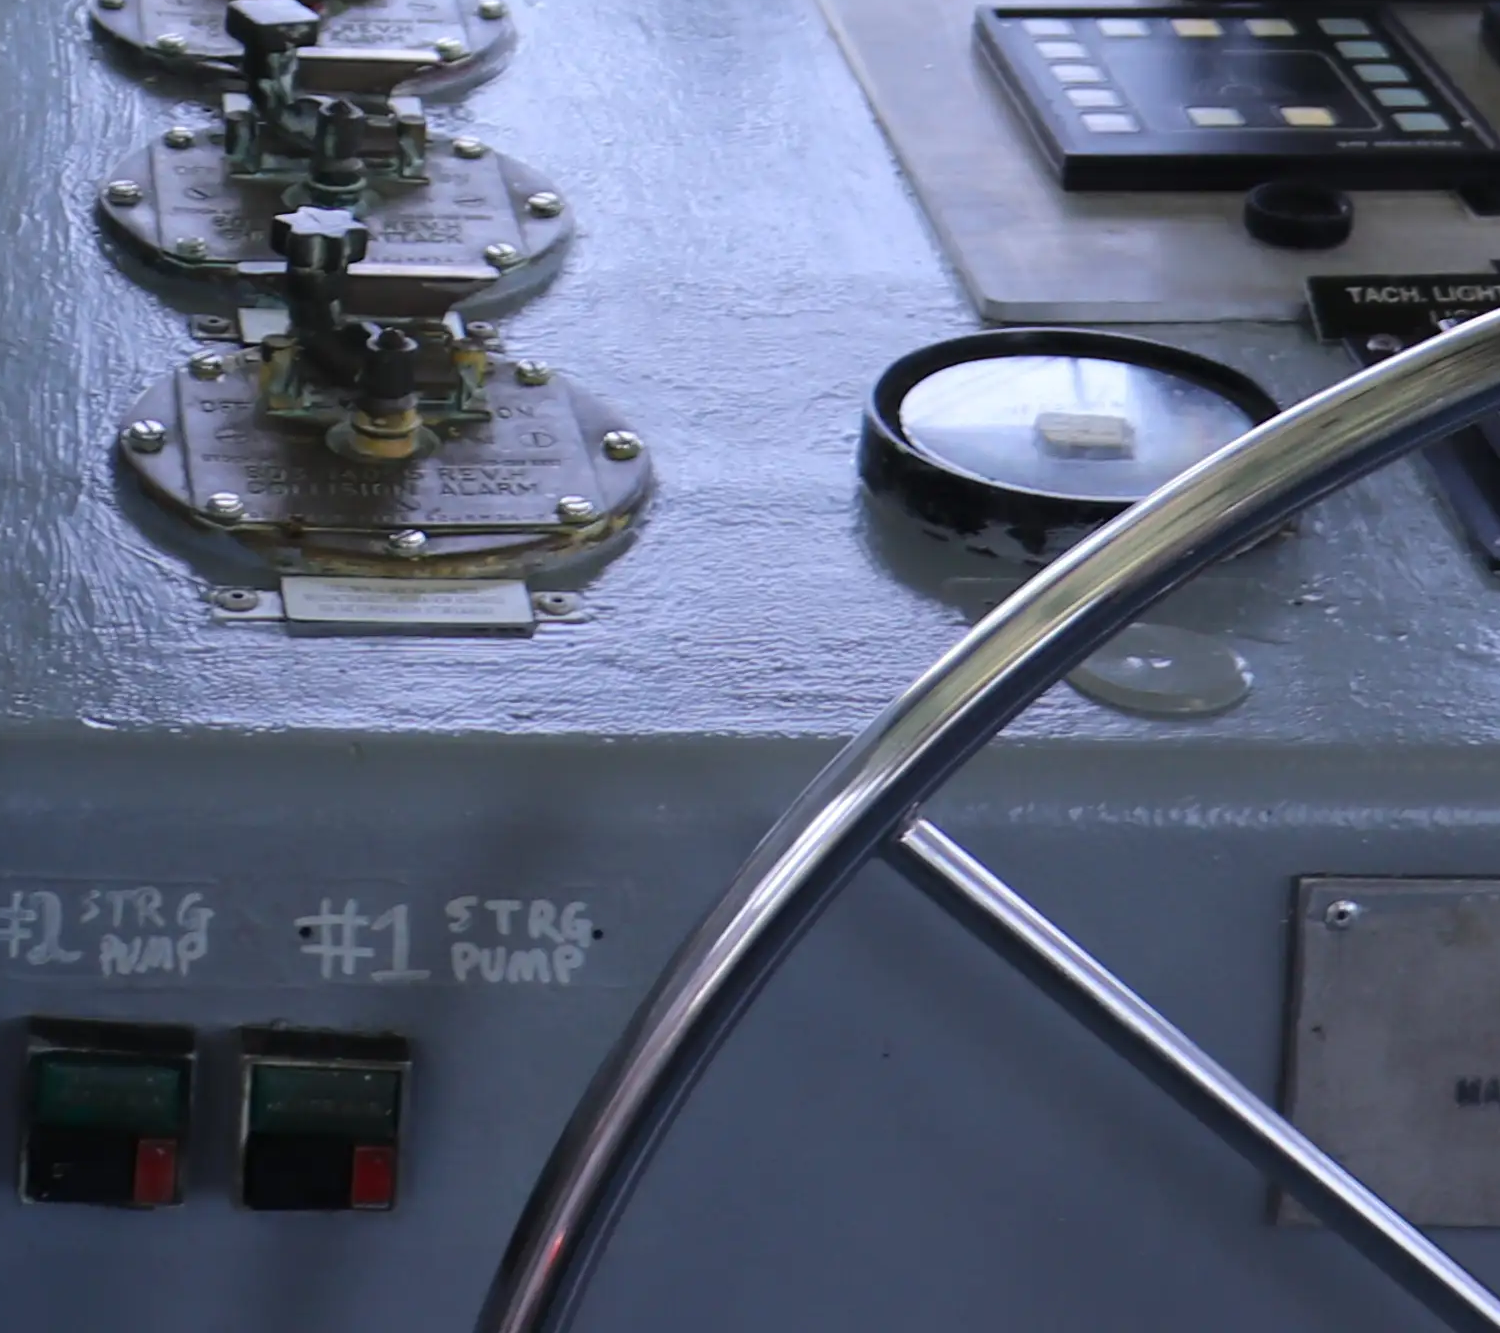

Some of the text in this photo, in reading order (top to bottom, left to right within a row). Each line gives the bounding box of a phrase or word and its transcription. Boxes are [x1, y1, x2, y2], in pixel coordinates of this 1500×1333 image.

[1345, 286, 1420, 305] TACH.
[439, 483, 540, 496] ALARM
[80, 887, 214, 931] STRG
[100, 932, 206, 977] PUMP
[297, 895, 594, 983] #1 STRG
[452, 941, 586, 983] PUMP
